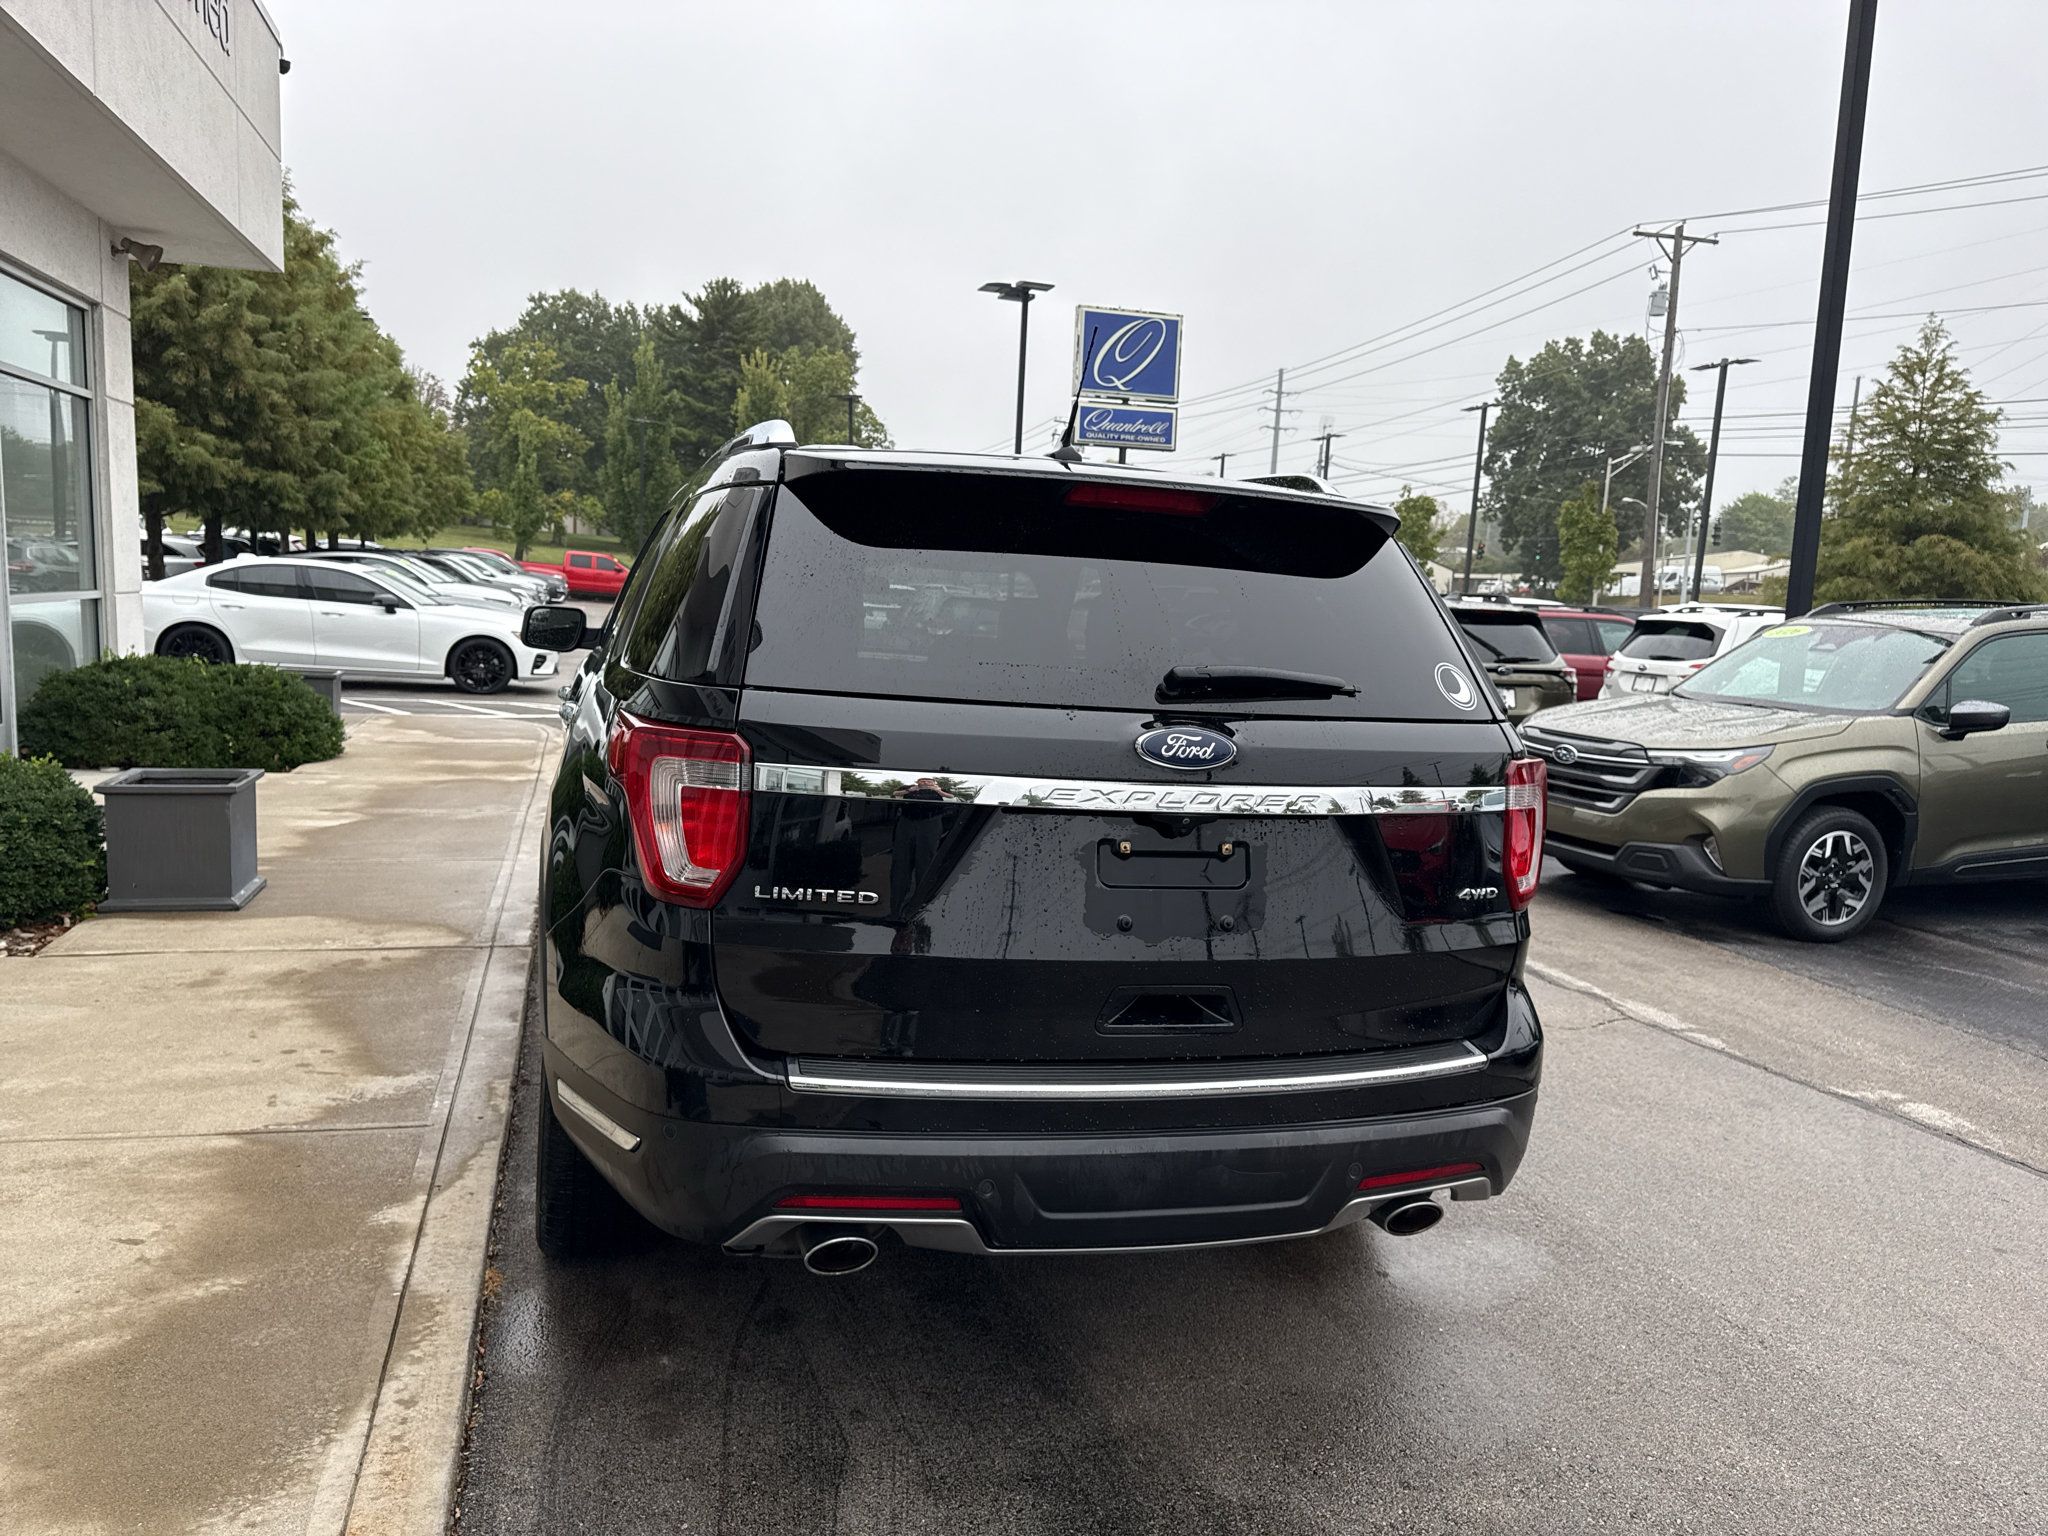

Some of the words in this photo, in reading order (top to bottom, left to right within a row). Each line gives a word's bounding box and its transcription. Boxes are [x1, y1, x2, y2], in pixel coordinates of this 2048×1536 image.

[1093, 318, 1166, 391] Q
[1083, 409, 1170, 435] Quantrell
[1086, 431, 1118, 440] QUALITY
[1120, 434, 1166, 443] PRE-OWNED
[1161, 733, 1216, 760] Ford
[1041, 787, 1321, 813] EXPLORER
[754, 885, 880, 904] LIMITED
[1458, 886, 1499, 900] 4WD
